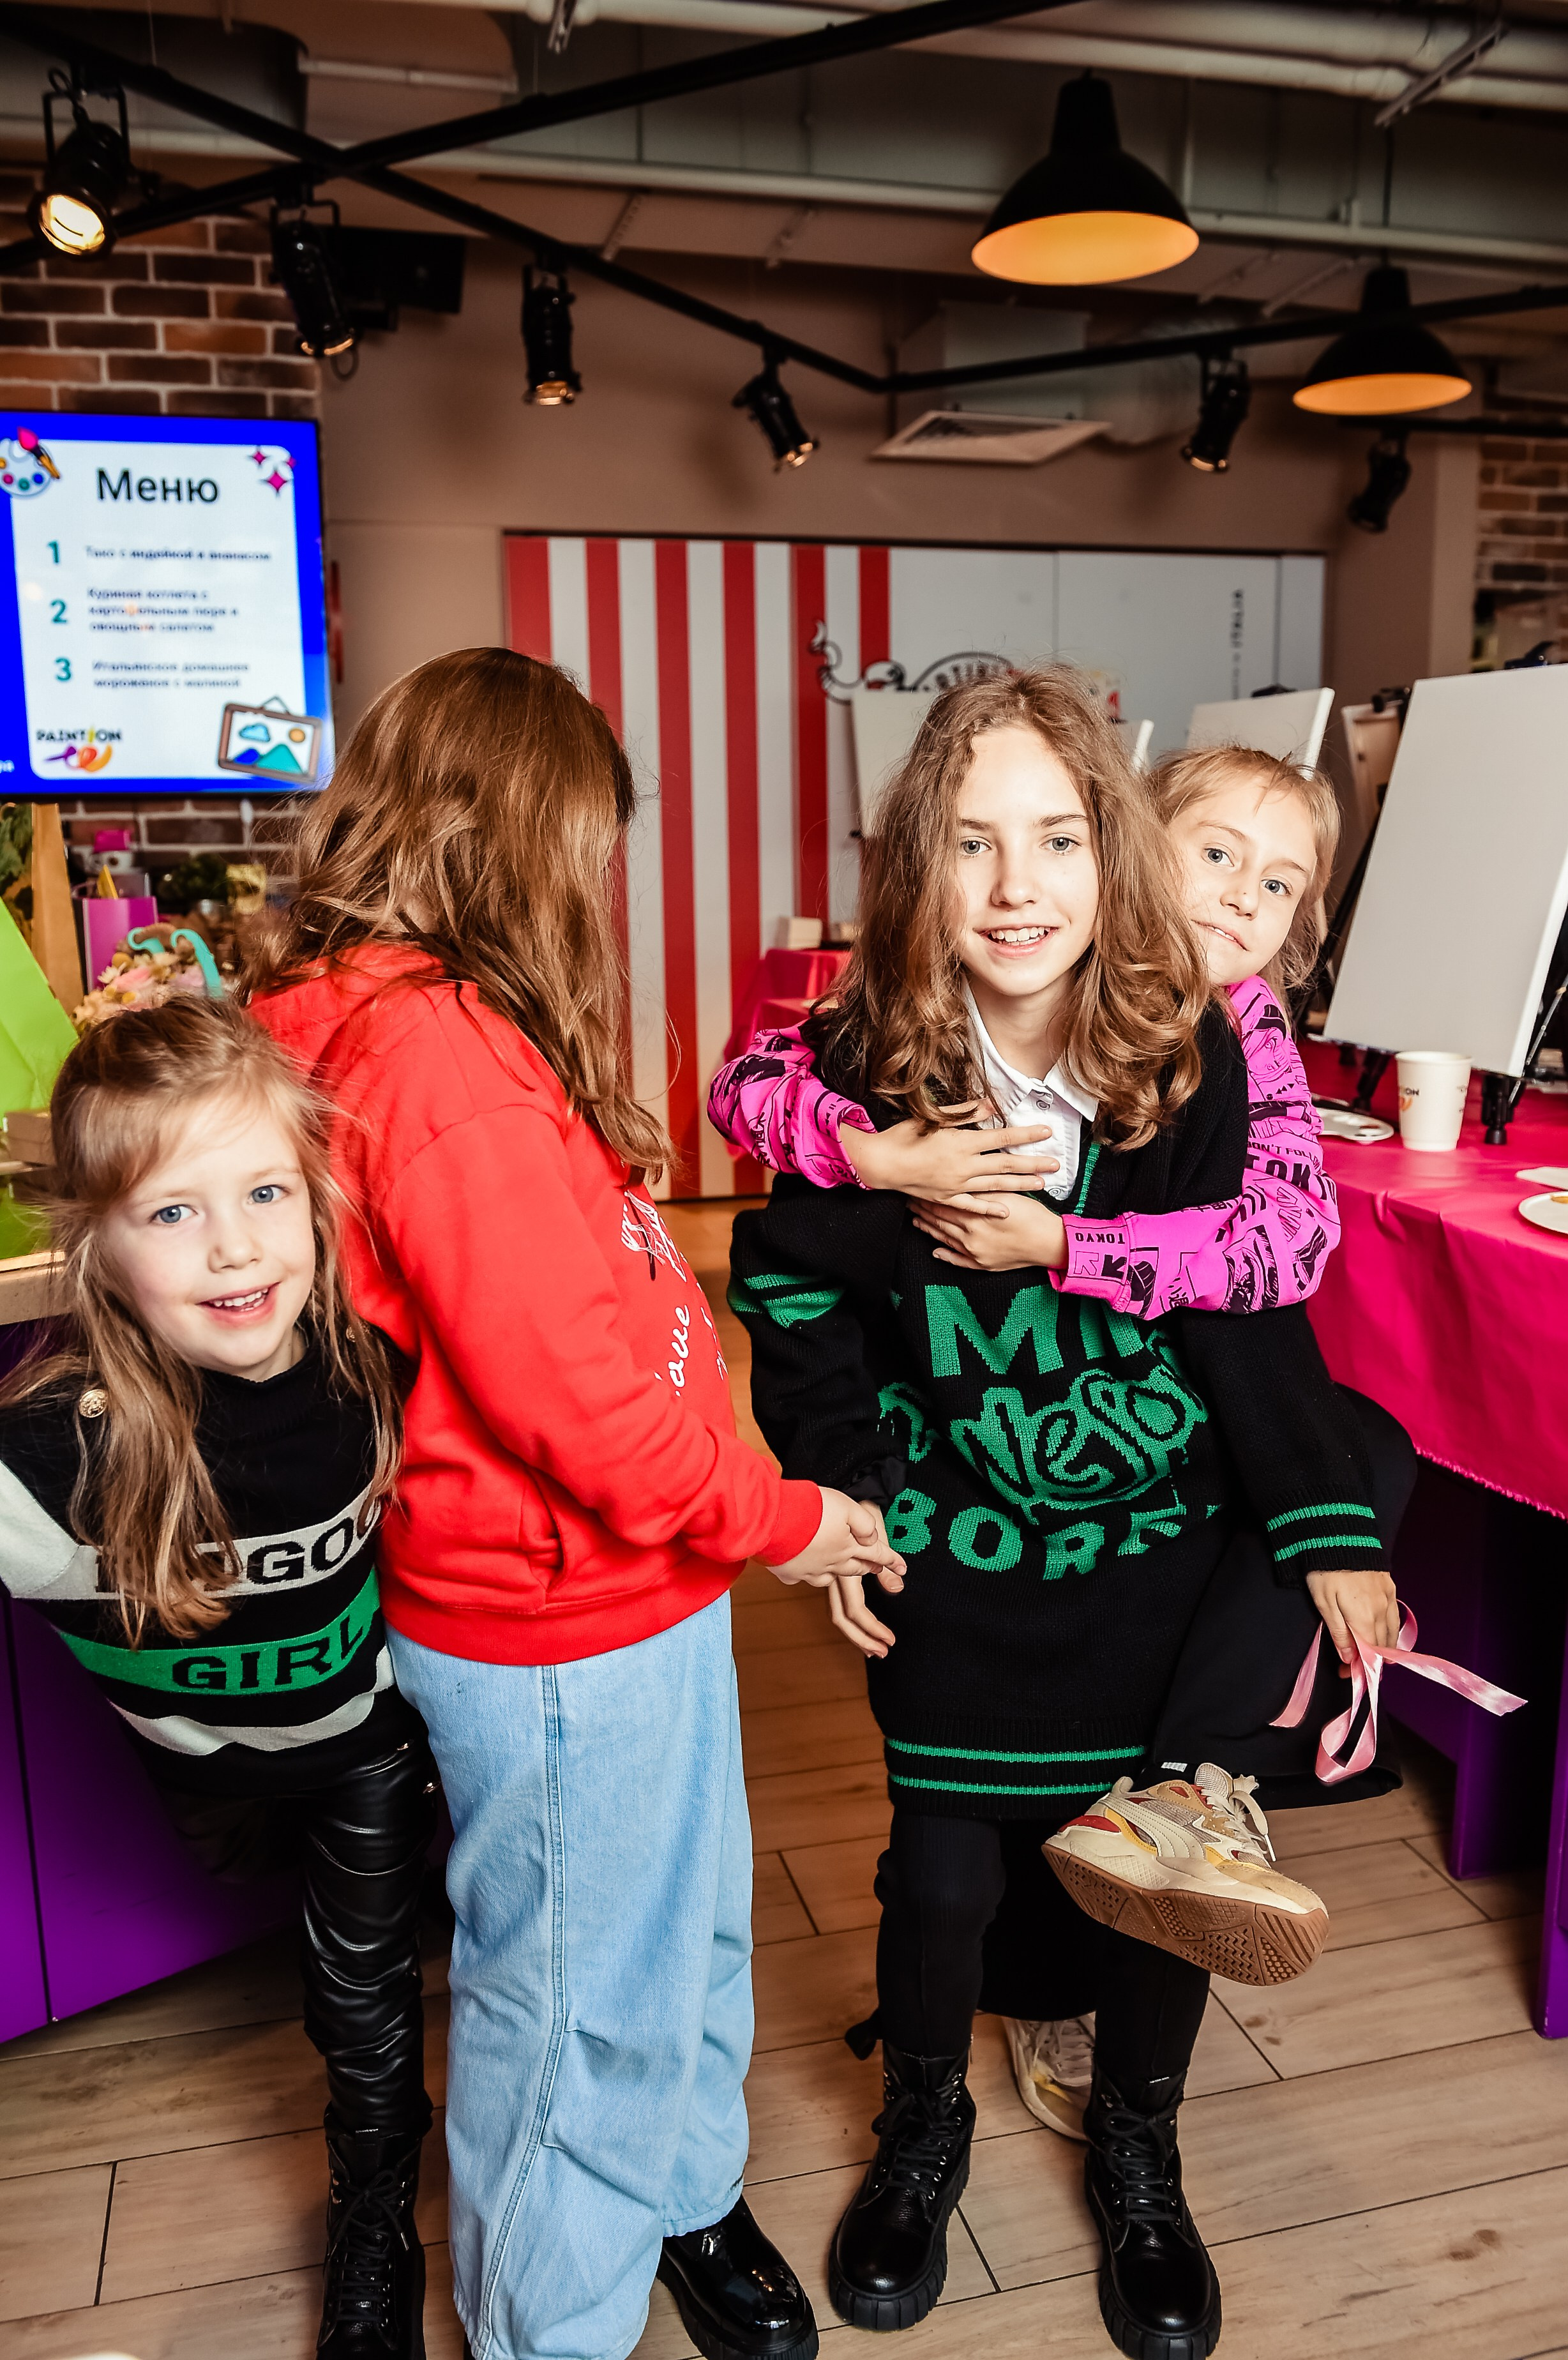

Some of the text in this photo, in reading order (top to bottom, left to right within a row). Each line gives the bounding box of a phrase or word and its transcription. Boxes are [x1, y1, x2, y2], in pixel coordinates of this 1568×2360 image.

[98, 469, 218, 503] Меню
[48, 541, 60, 563] 1
[51, 600, 68, 624] 2
[55, 658, 72, 682] 3
[1075, 1232, 1126, 1244] TOKYO
[172, 1613, 365, 1690] GIRL
